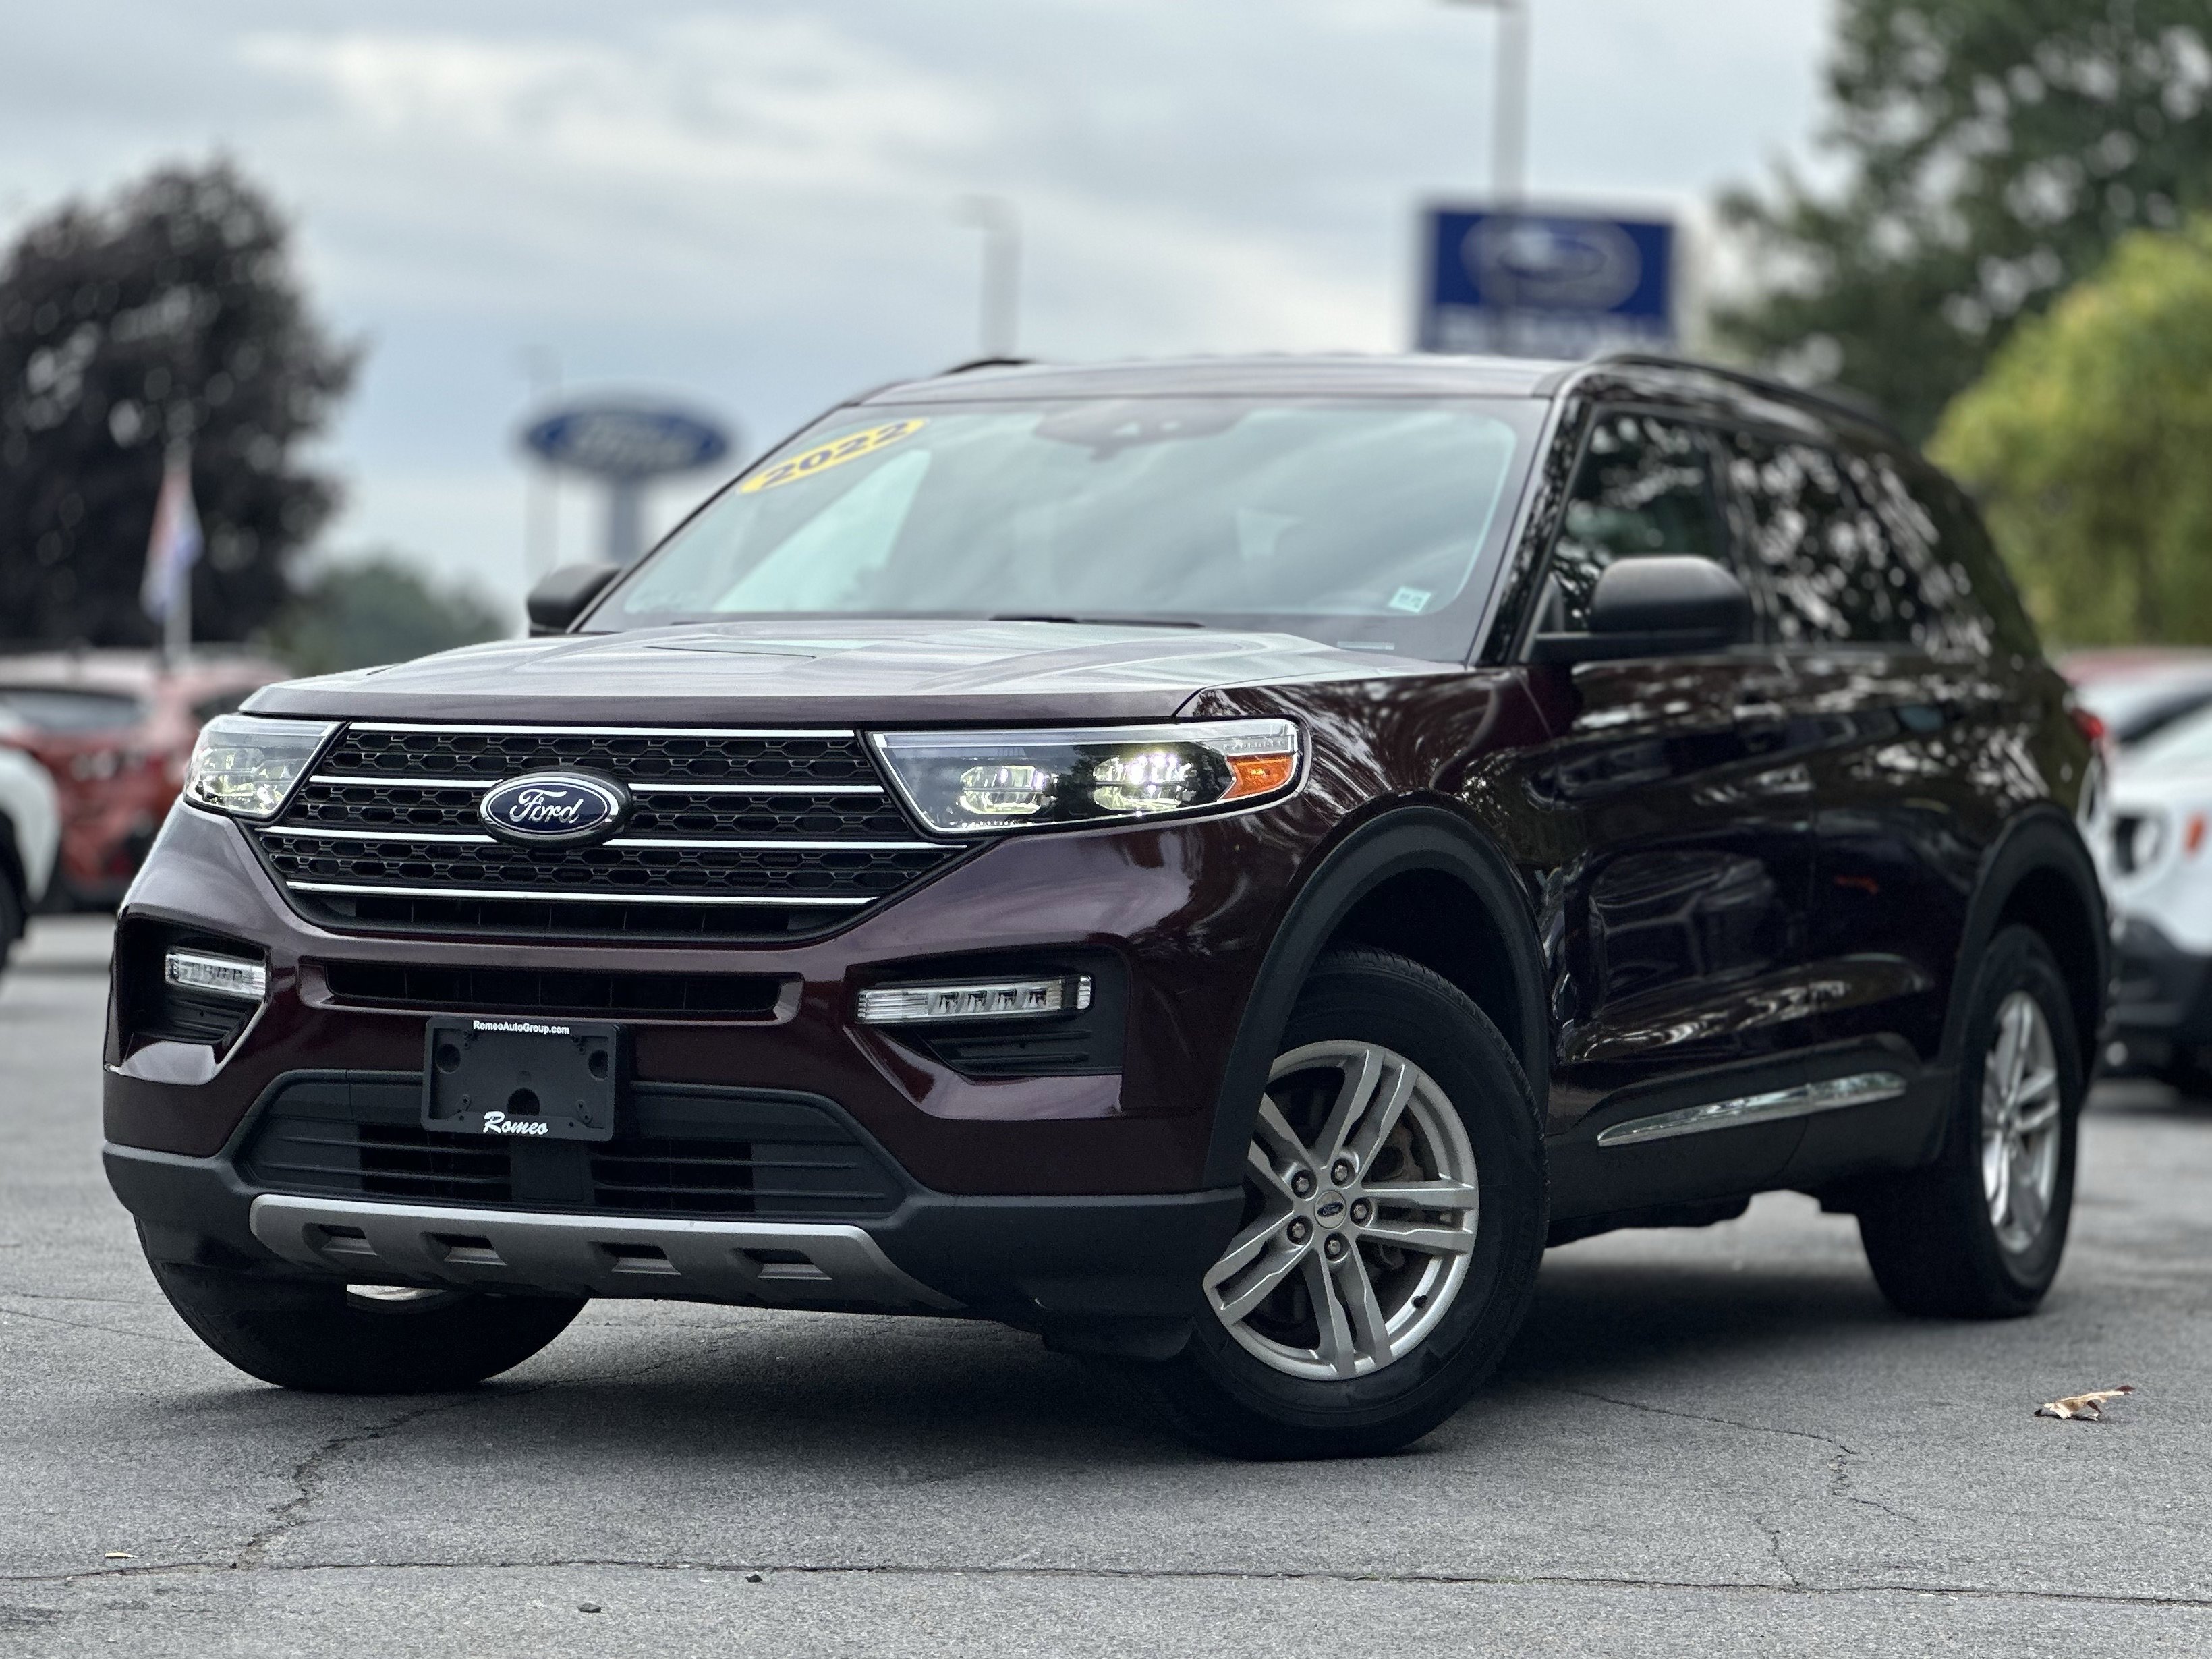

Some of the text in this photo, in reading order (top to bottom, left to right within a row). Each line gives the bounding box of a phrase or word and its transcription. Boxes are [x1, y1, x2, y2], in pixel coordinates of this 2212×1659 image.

[761, 422, 908, 488] 2022
[509, 789, 584, 824] Ford
[473, 1020, 570, 1035] RomeoAutoGroup.com
[482, 1110, 549, 1135] Romeo
